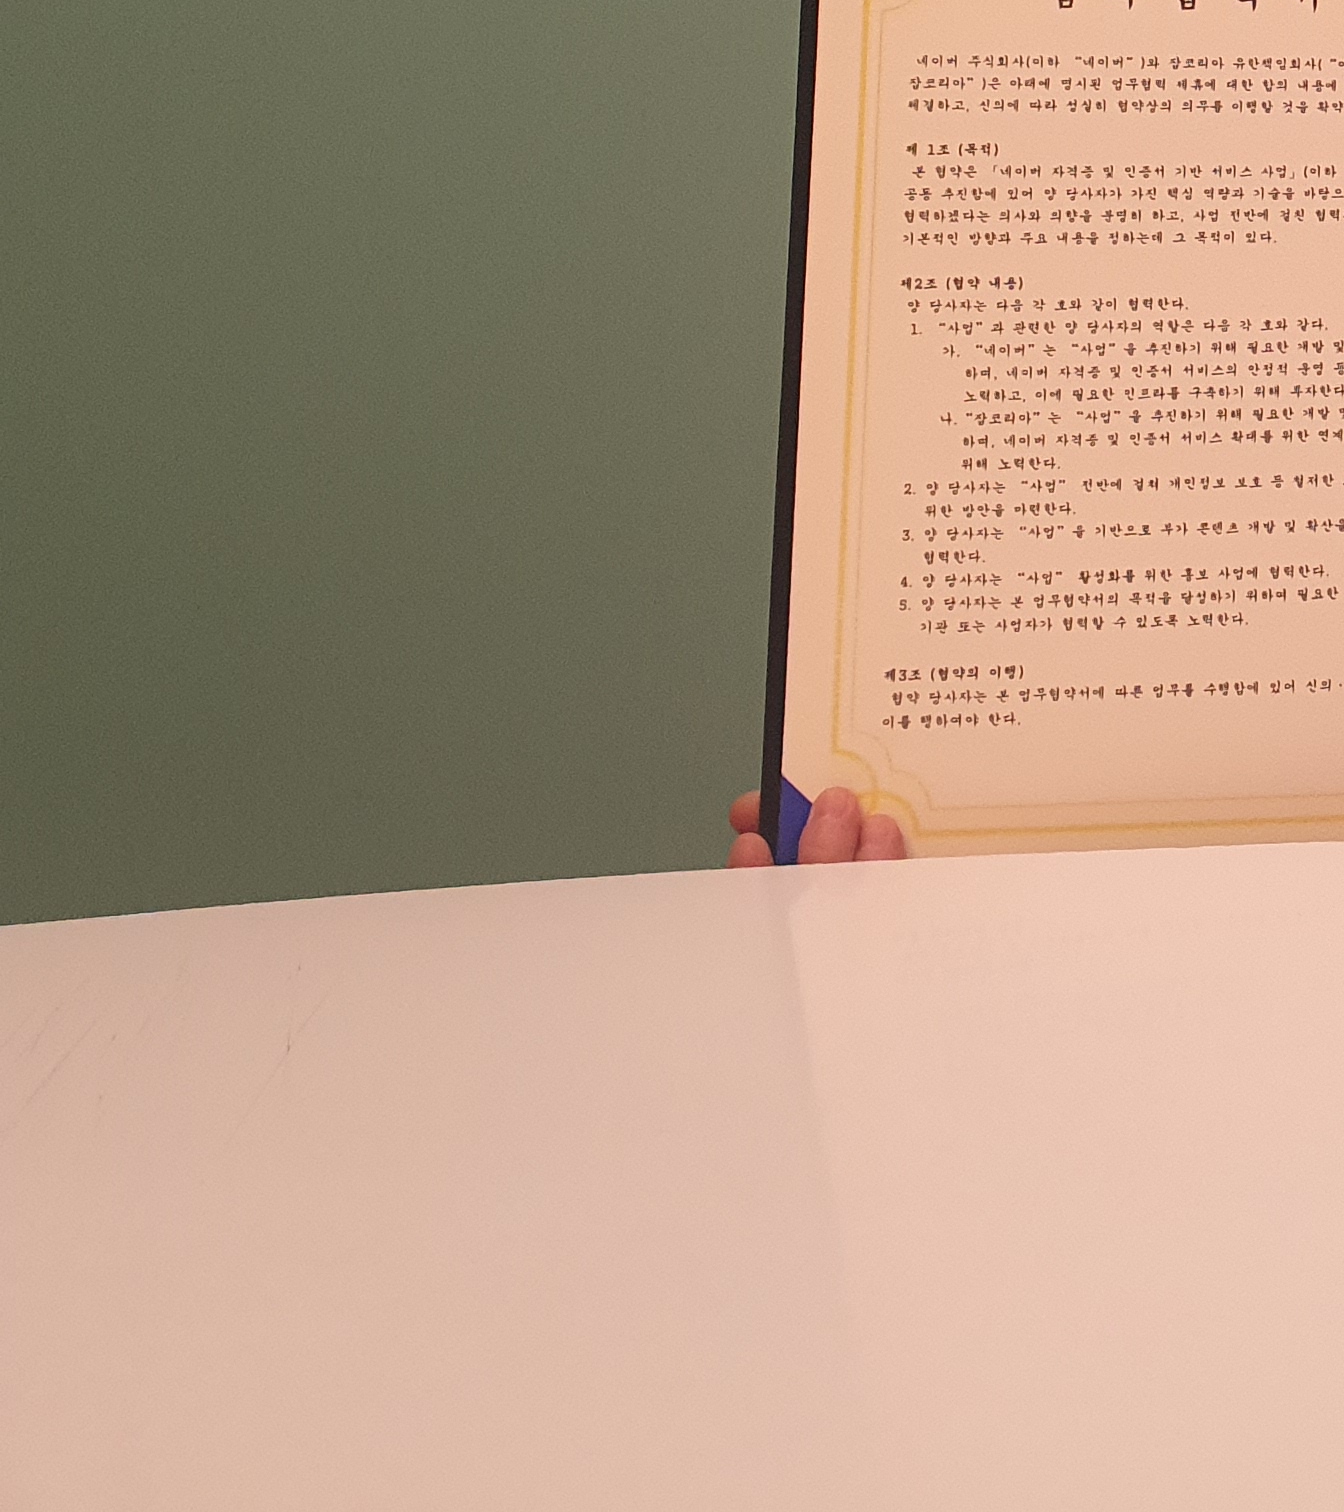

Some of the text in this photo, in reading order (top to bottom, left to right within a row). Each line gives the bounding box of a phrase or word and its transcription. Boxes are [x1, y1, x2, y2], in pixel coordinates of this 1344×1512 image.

[979, 98, 1020, 113] 신의에
[1028, 98, 1058, 113] 따라
[1066, 98, 1107, 114] 성실히
[1117, 98, 1172, 114] 협약상의
[1181, 99, 1224, 114] 의무를
[1231, 99, 1274, 115] 이행할
[1282, 99, 1309, 115] 것을
[905, 142, 999, 158] 제 1조 (목적)
[902, 230, 1277, 247] 기본적인 방향과 주요 내용을 정하는데 그 목적이 있다.
[900, 275, 1024, 292] 제2조 (협약 내용)
[907, 296, 1189, 314] 양 당사자는 다음 각 호와 같이 협력한다.
[920, 611, 1249, 635] 기관 또는 사업자가 협력할 수 있도록 노력한다.
[884, 667, 922, 683] 제3조
[930, 665, 980, 683] (협약의
[881, 714, 912, 730] 이를
[988, 711, 1021, 728] 한다.
